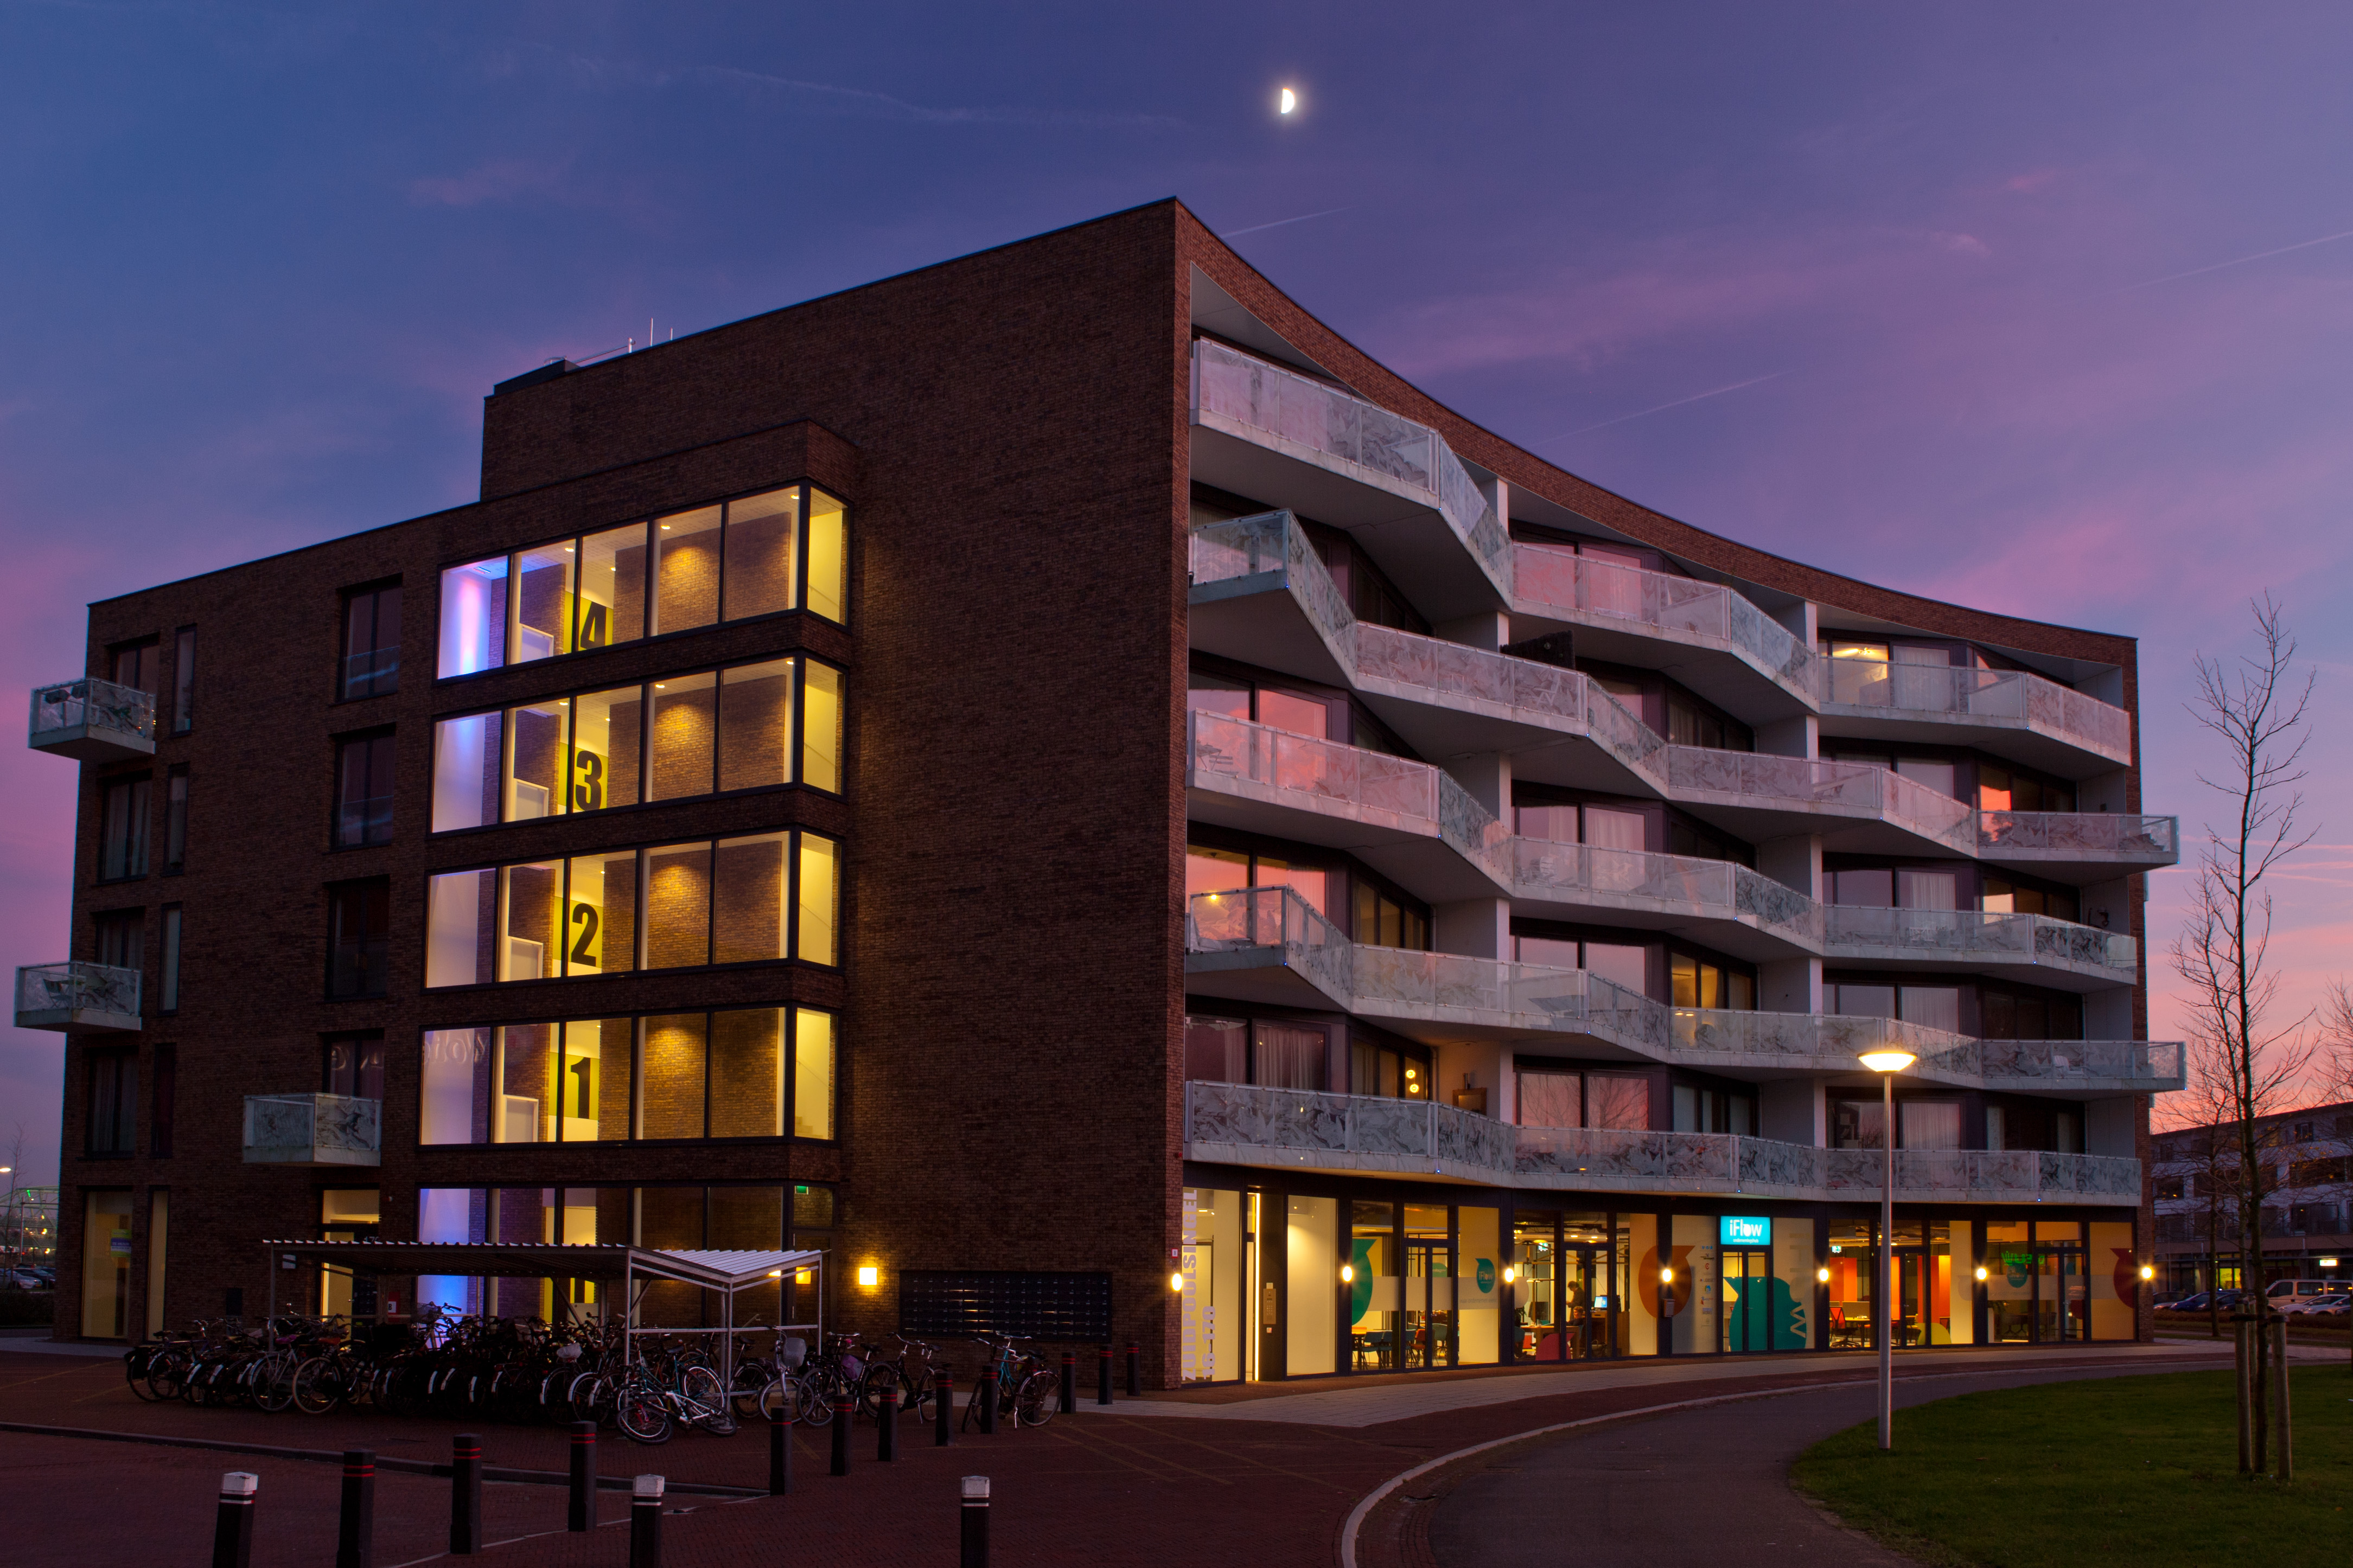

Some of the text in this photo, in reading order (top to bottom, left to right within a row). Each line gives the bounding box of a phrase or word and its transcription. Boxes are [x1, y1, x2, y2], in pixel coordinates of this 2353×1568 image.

[580, 601, 606, 650] 4
[576, 750, 602, 811] 3
[570, 903, 599, 966] 2
[570, 1057, 591, 1120] 1
[1730, 1219, 1762, 1237] iFlow
[1182, 1189, 1197, 1381] ZUIDPOOLSINGEL
[1478, 1271, 1493, 1280] iFlow
[1202, 1305, 1216, 1380] 16-170
